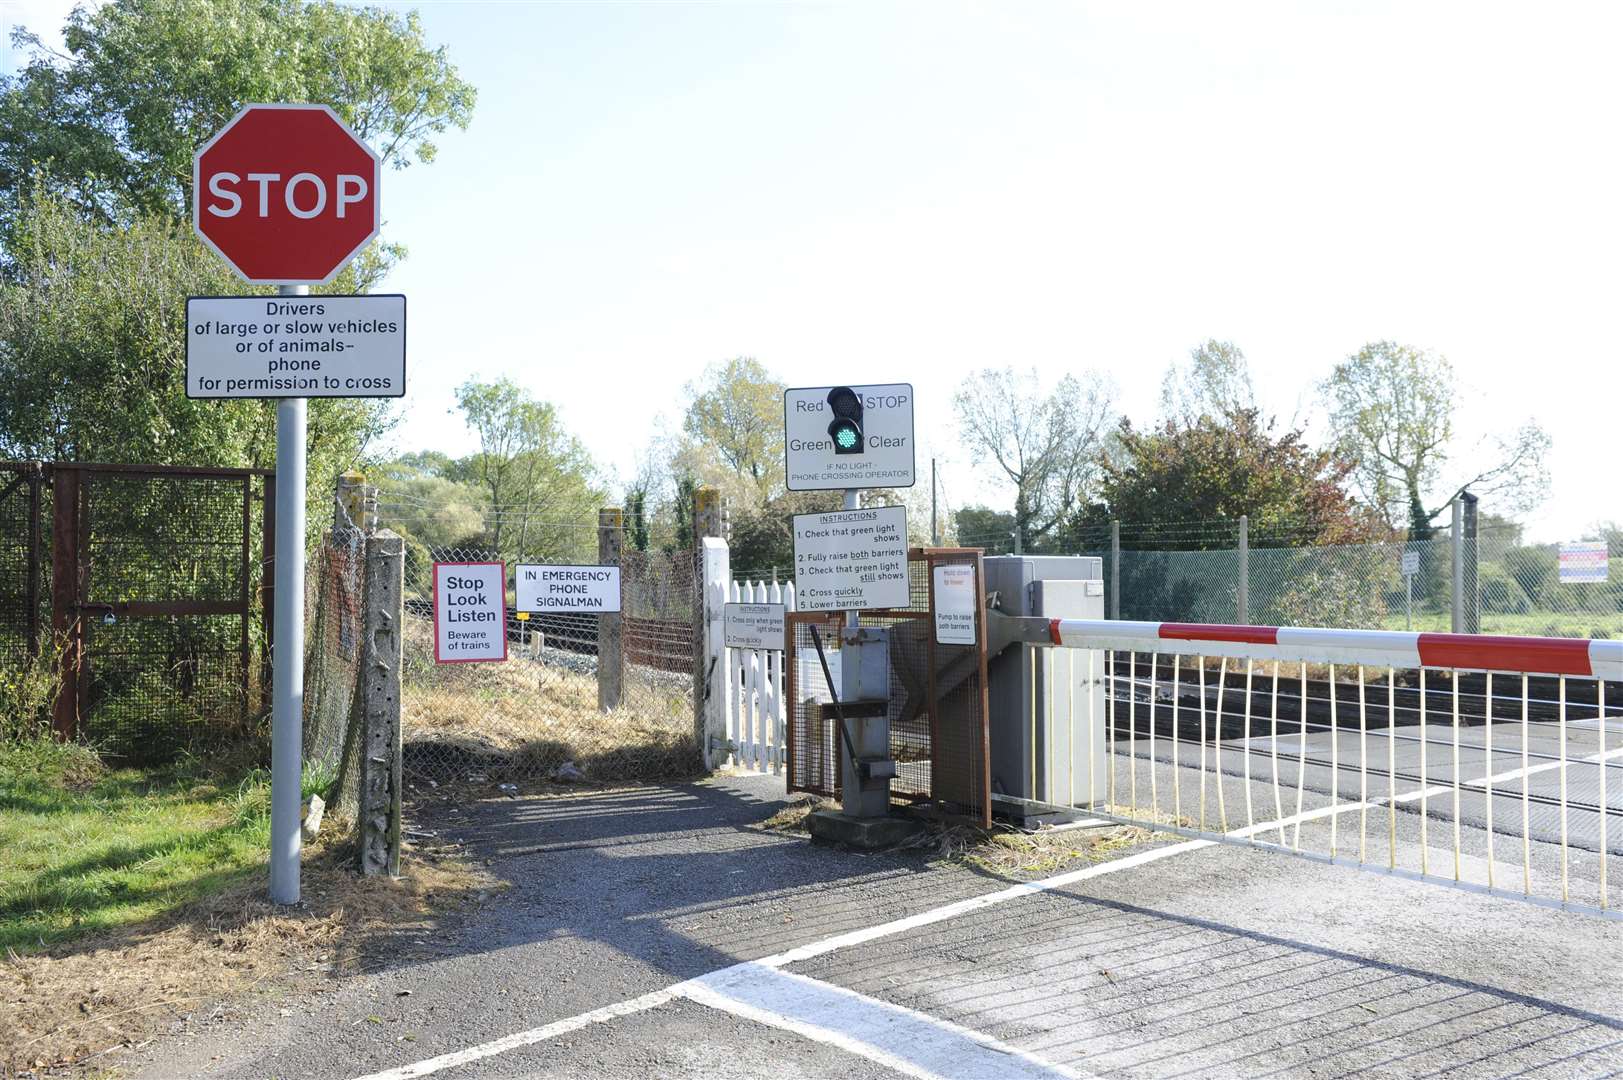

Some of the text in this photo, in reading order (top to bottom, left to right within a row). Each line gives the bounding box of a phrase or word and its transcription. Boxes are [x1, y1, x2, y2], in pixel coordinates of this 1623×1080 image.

[208, 172, 368, 219] STOP
[266, 302, 324, 316] Drivers
[195, 320, 397, 337] of large or slow vehicles
[236, 342, 252, 352] or
[258, 339, 274, 352] of
[268, 358, 320, 374] phone
[199, 376, 391, 392] for permission to cross
[796, 396, 908, 412] Red STOP
[790, 436, 906, 451] Green Clear
[821, 472, 864, 480] CROSSING
[865, 470, 910, 478] OPERATOR
[820, 512, 877, 522] INSTRUCTIONS
[805, 530, 830, 538] Check
[832, 528, 848, 536] that
[851, 526, 874, 536] green
[876, 524, 895, 535] light
[874, 534, 900, 542] shows
[808, 553, 826, 562] Fully
[830, 552, 848, 560] raise
[850, 550, 868, 559] both
[872, 548, 904, 558] barriers
[808, 566, 834, 575] Check
[836, 565, 852, 573] that
[854, 564, 878, 573] green
[880, 562, 899, 572] light
[526, 571, 611, 581] IN EMERGENCY
[860, 573, 876, 581] still
[448, 576, 484, 592] Stop
[550, 584, 588, 594] PHONE
[810, 588, 832, 596] Cross
[834, 587, 863, 597] quickly
[448, 592, 487, 606] Look
[536, 597, 602, 607] SIGNALMAN
[810, 600, 834, 608] Lower
[836, 599, 867, 608] barriers
[448, 610, 496, 622] Listen
[448, 631, 486, 640] Beware
[448, 641, 490, 650] of trains
